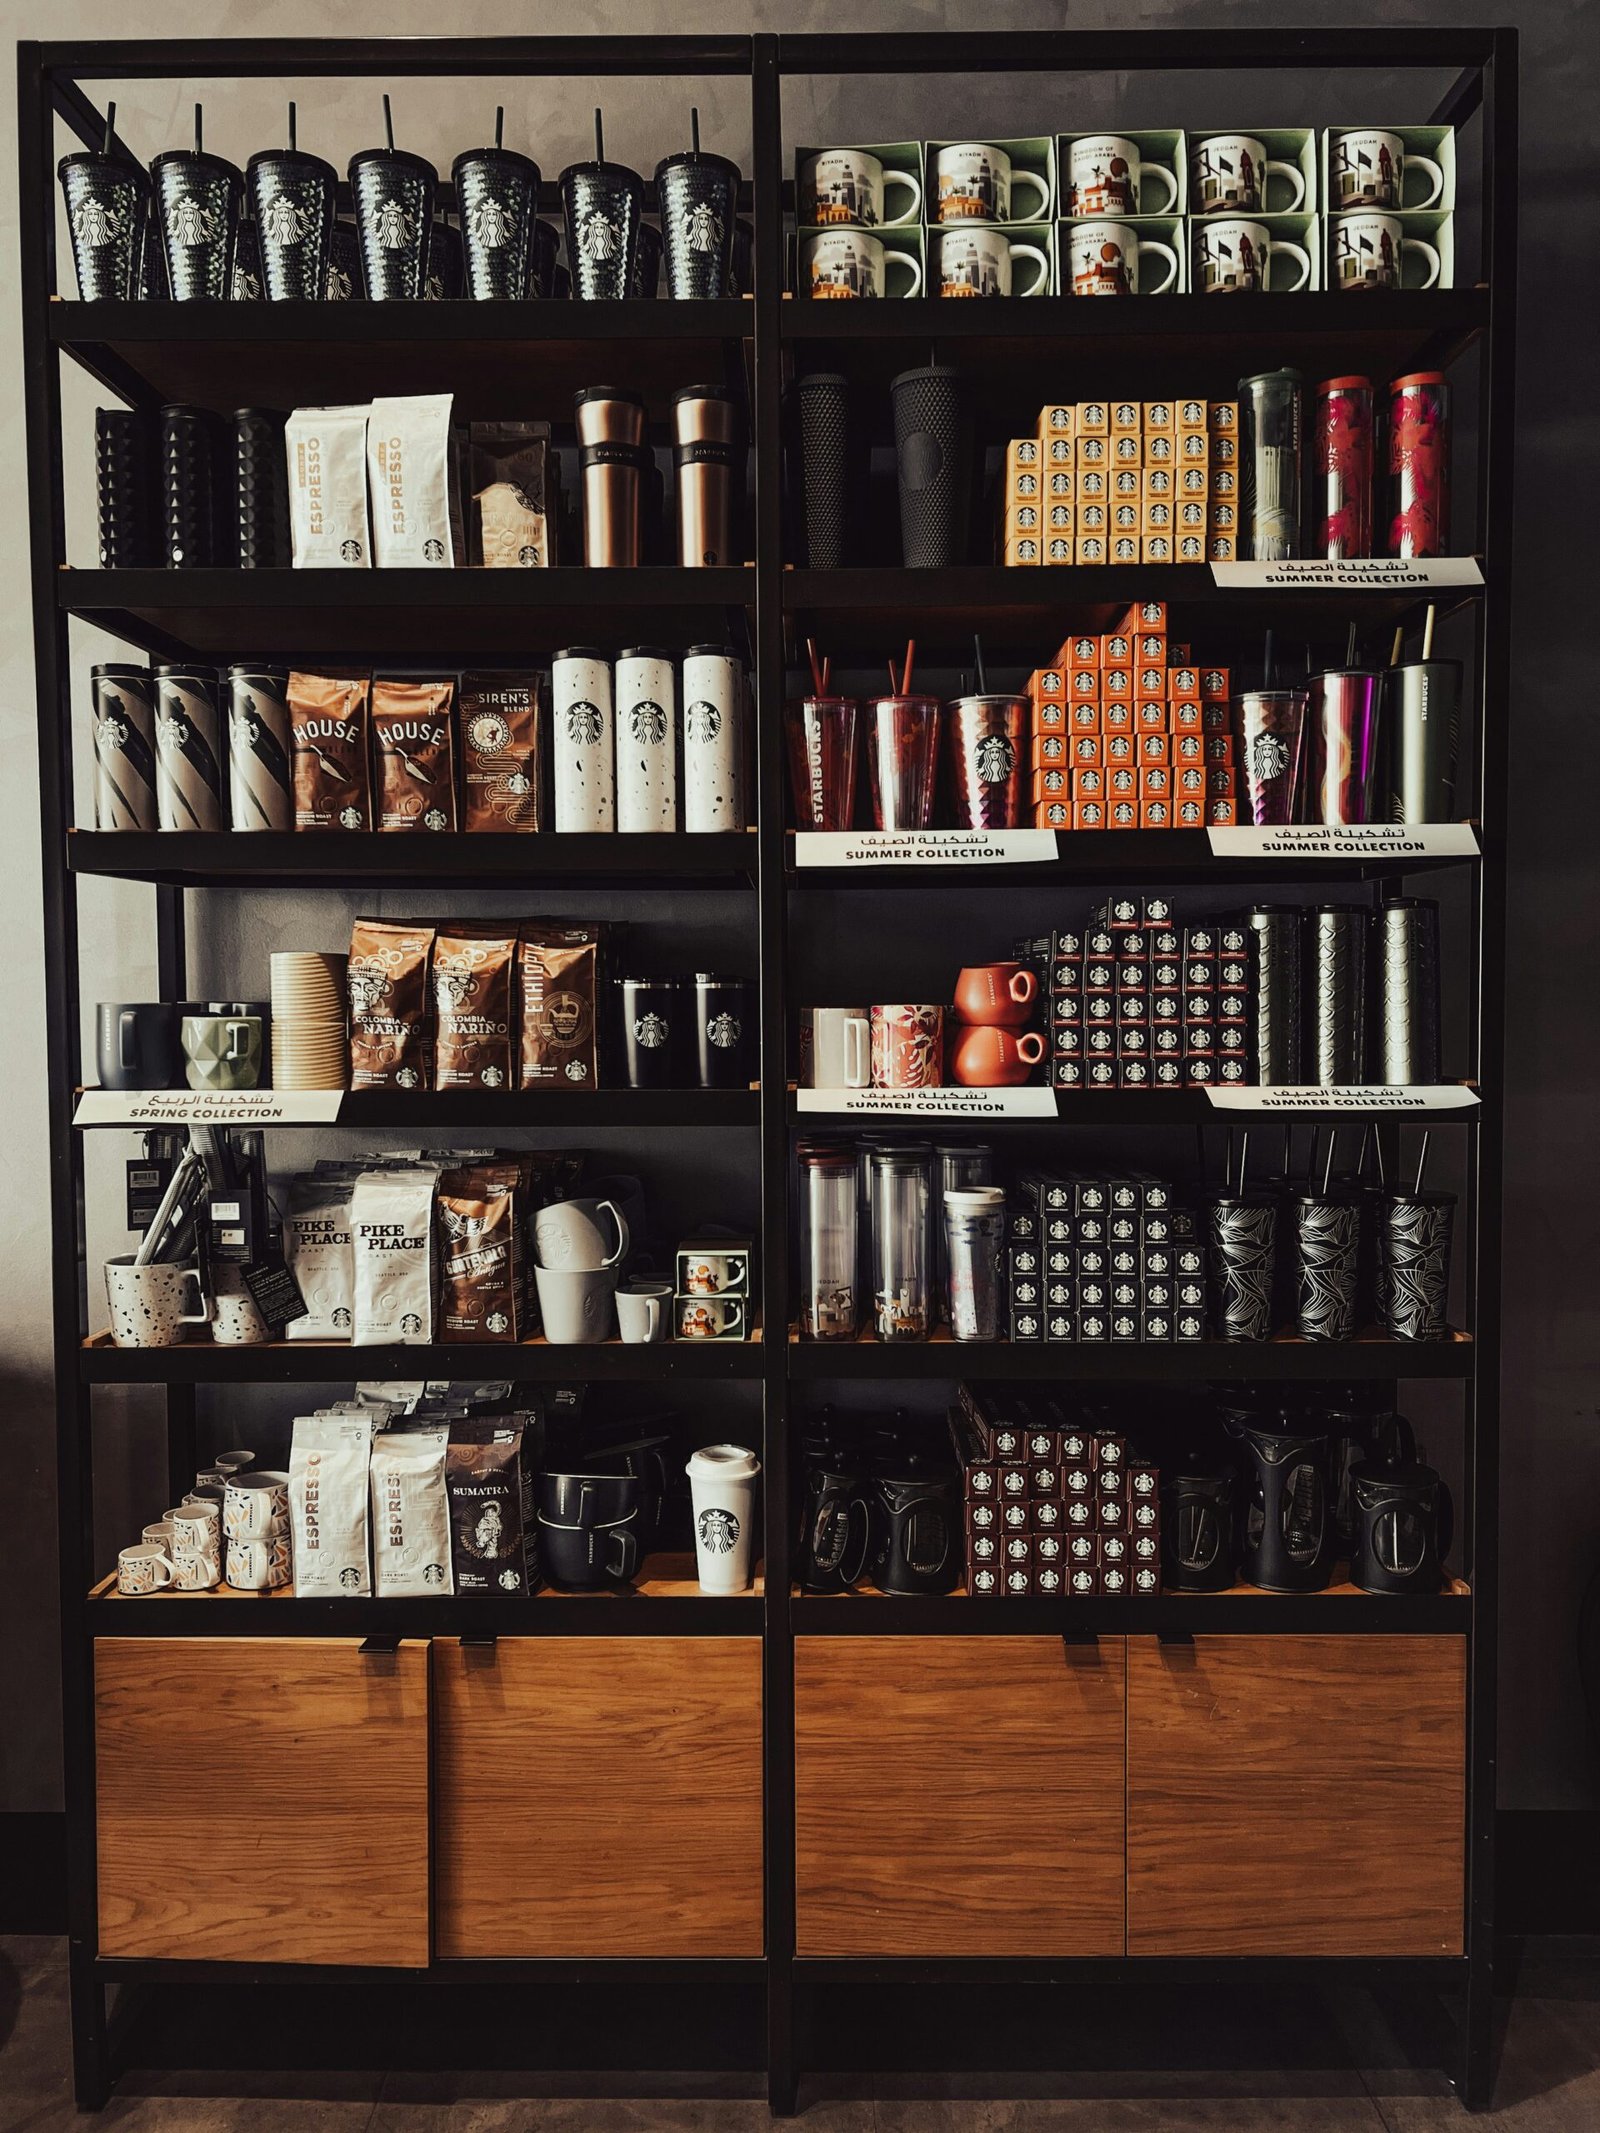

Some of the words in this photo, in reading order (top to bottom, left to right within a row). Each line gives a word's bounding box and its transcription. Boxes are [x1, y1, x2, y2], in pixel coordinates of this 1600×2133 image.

[308, 437, 323, 535] ESPRESSO
[389, 437, 405, 535] ESPRESSO
[1278, 562, 1334, 573] الصيف
[1337, 562, 1409, 573] تشكيلة
[1265, 574, 1334, 583] SUMMER
[1337, 573, 1429, 583] COLLECTION
[478, 693, 529, 704] SIREN'S
[292, 719, 359, 744] HOUSE
[377, 721, 445, 746] HOUSE
[810, 720, 824, 824] STARBUCKS
[1275, 828, 1330, 840] الصيف
[1334, 827, 1406, 839] تشكيلة
[860, 835, 914, 847] الصيف
[918, 834, 988, 846] تشكيلة
[1262, 842, 1330, 851] SUMMER
[1334, 842, 1425, 851] COLLECTION
[846, 849, 912, 859] SUMMER
[916, 848, 1005, 858] COLLECTION
[523, 942, 545, 1014] ETHIOPIA
[356, 1015, 400, 1025] COLOMBIA
[441, 1015, 486, 1023] COLOMBIA
[363, 1022, 420, 1035] NARIÑO
[448, 1020, 507, 1034] NARIÑO
[861, 1091, 914, 1101] الصيف
[918, 1090, 987, 1101] تشكيلة
[1273, 1088, 1329, 1097] الصيف
[1332, 1088, 1404, 1097] تشكيلة
[148, 1095, 201, 1107] الربيع
[204, 1094, 274, 1106] تشكيلة
[1261, 1099, 1330, 1107] SUMMER
[1334, 1098, 1426, 1107] COLLECTION
[846, 1101, 911, 1110] SUMMER
[916, 1102, 1005, 1112] COLLECTION
[129, 1108, 188, 1118] SPRING
[192, 1108, 283, 1118] COLLECTION
[292, 1220, 335, 1232] PIKE
[360, 1224, 405, 1237] PIKE
[368, 1237, 425, 1250] PLACE
[446, 1246, 508, 1275] GUATEMALA
[453, 1486, 510, 1496] SUMATRA
[305, 1453, 321, 1550] ESPRESSO
